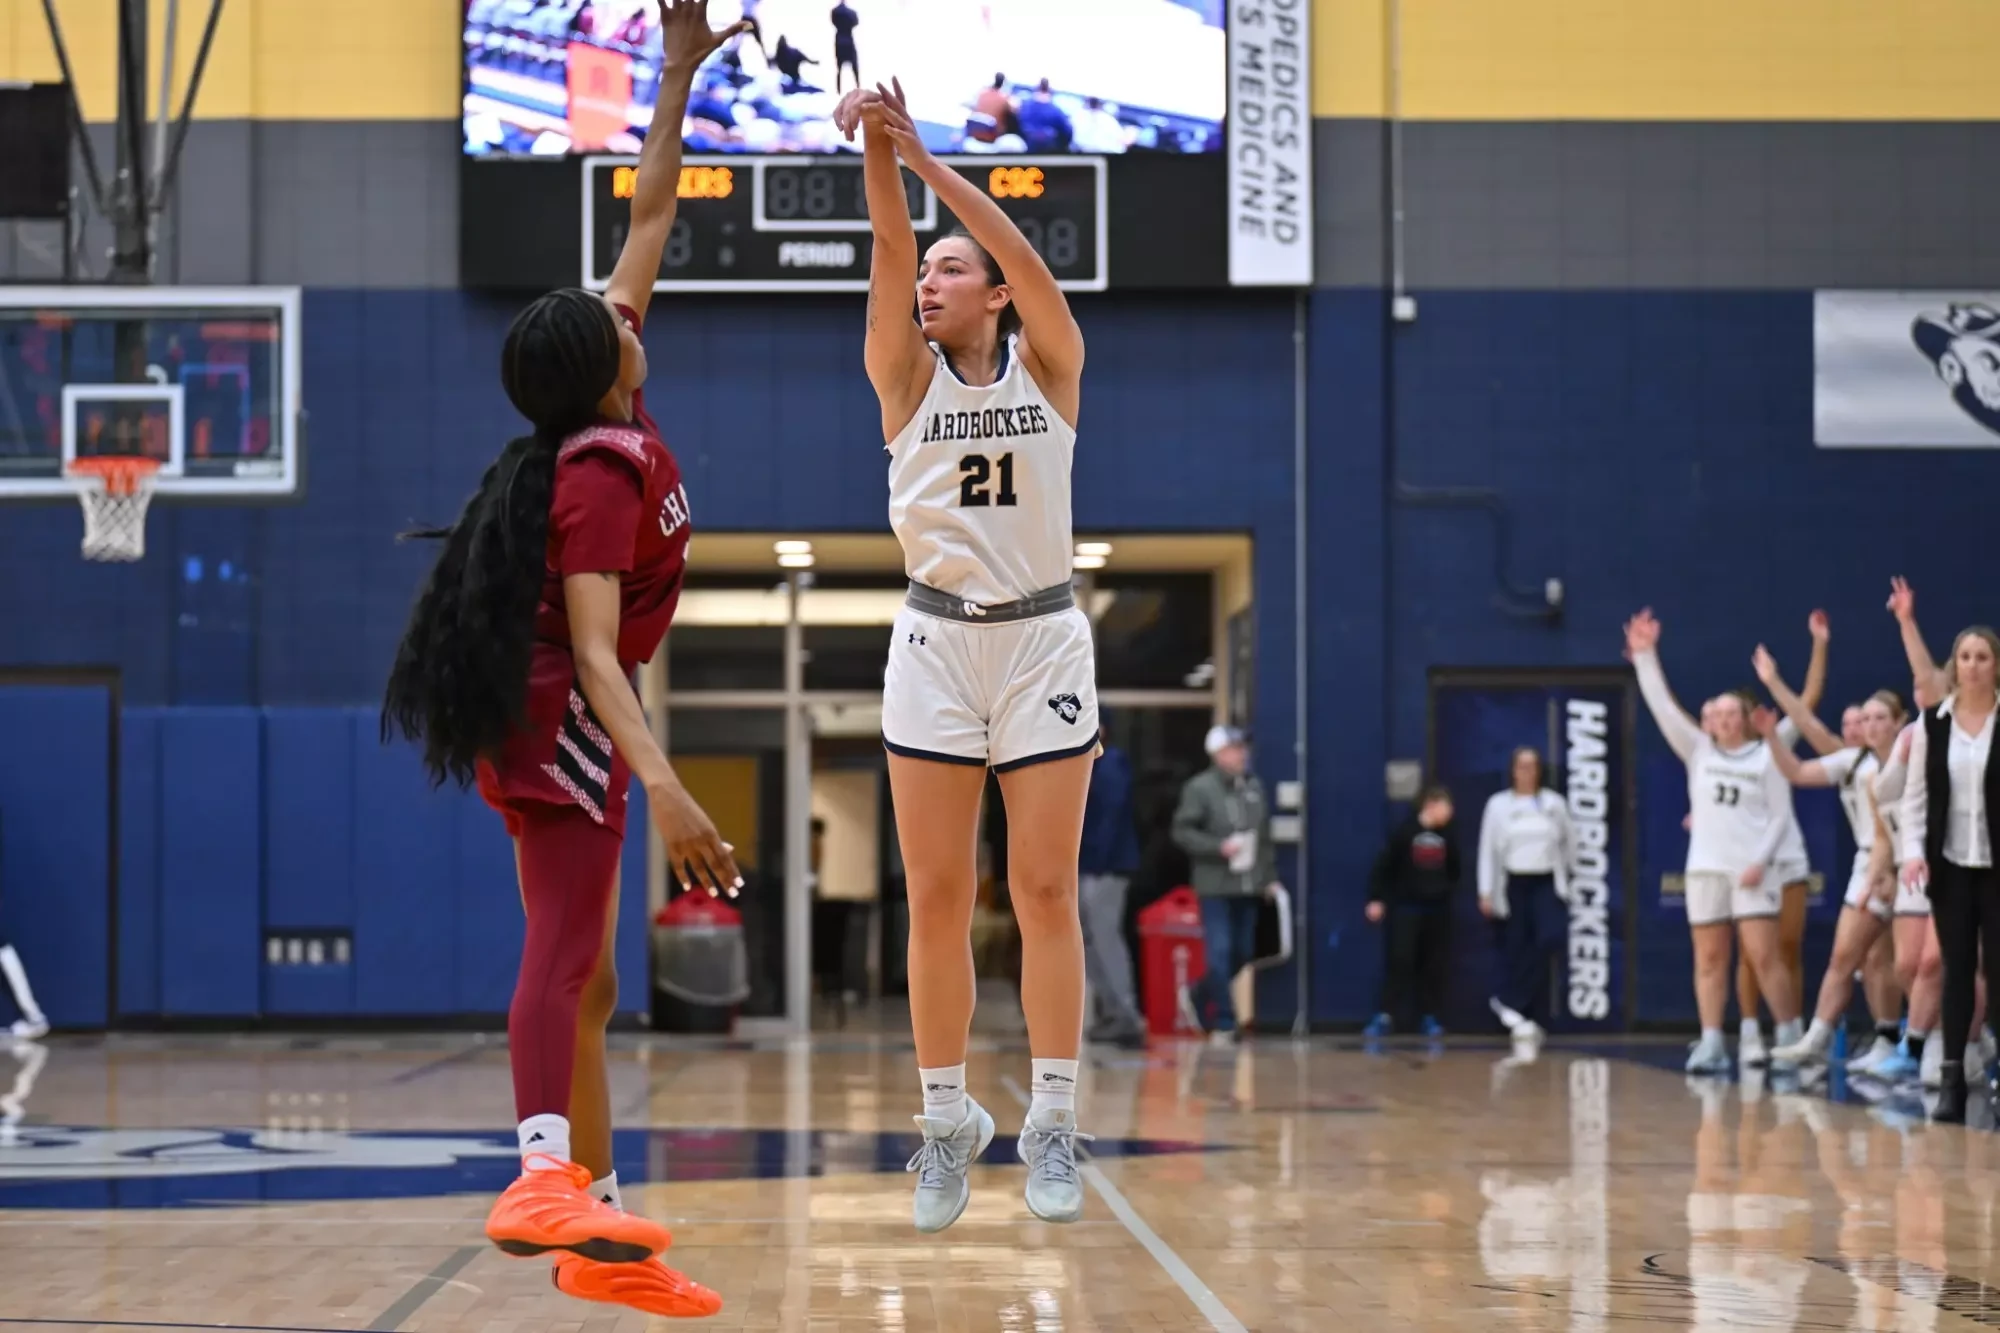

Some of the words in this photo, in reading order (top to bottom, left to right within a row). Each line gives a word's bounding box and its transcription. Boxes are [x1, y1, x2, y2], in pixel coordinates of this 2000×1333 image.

[1237, 41, 1266, 239] MEDICINE
[989, 167, 1044, 198] CSC
[1272, 160, 1300, 245] AND
[779, 241, 855, 267] PERIOD
[959, 452, 1018, 508] 21
[1566, 699, 1609, 1020] HARDROCKERS
